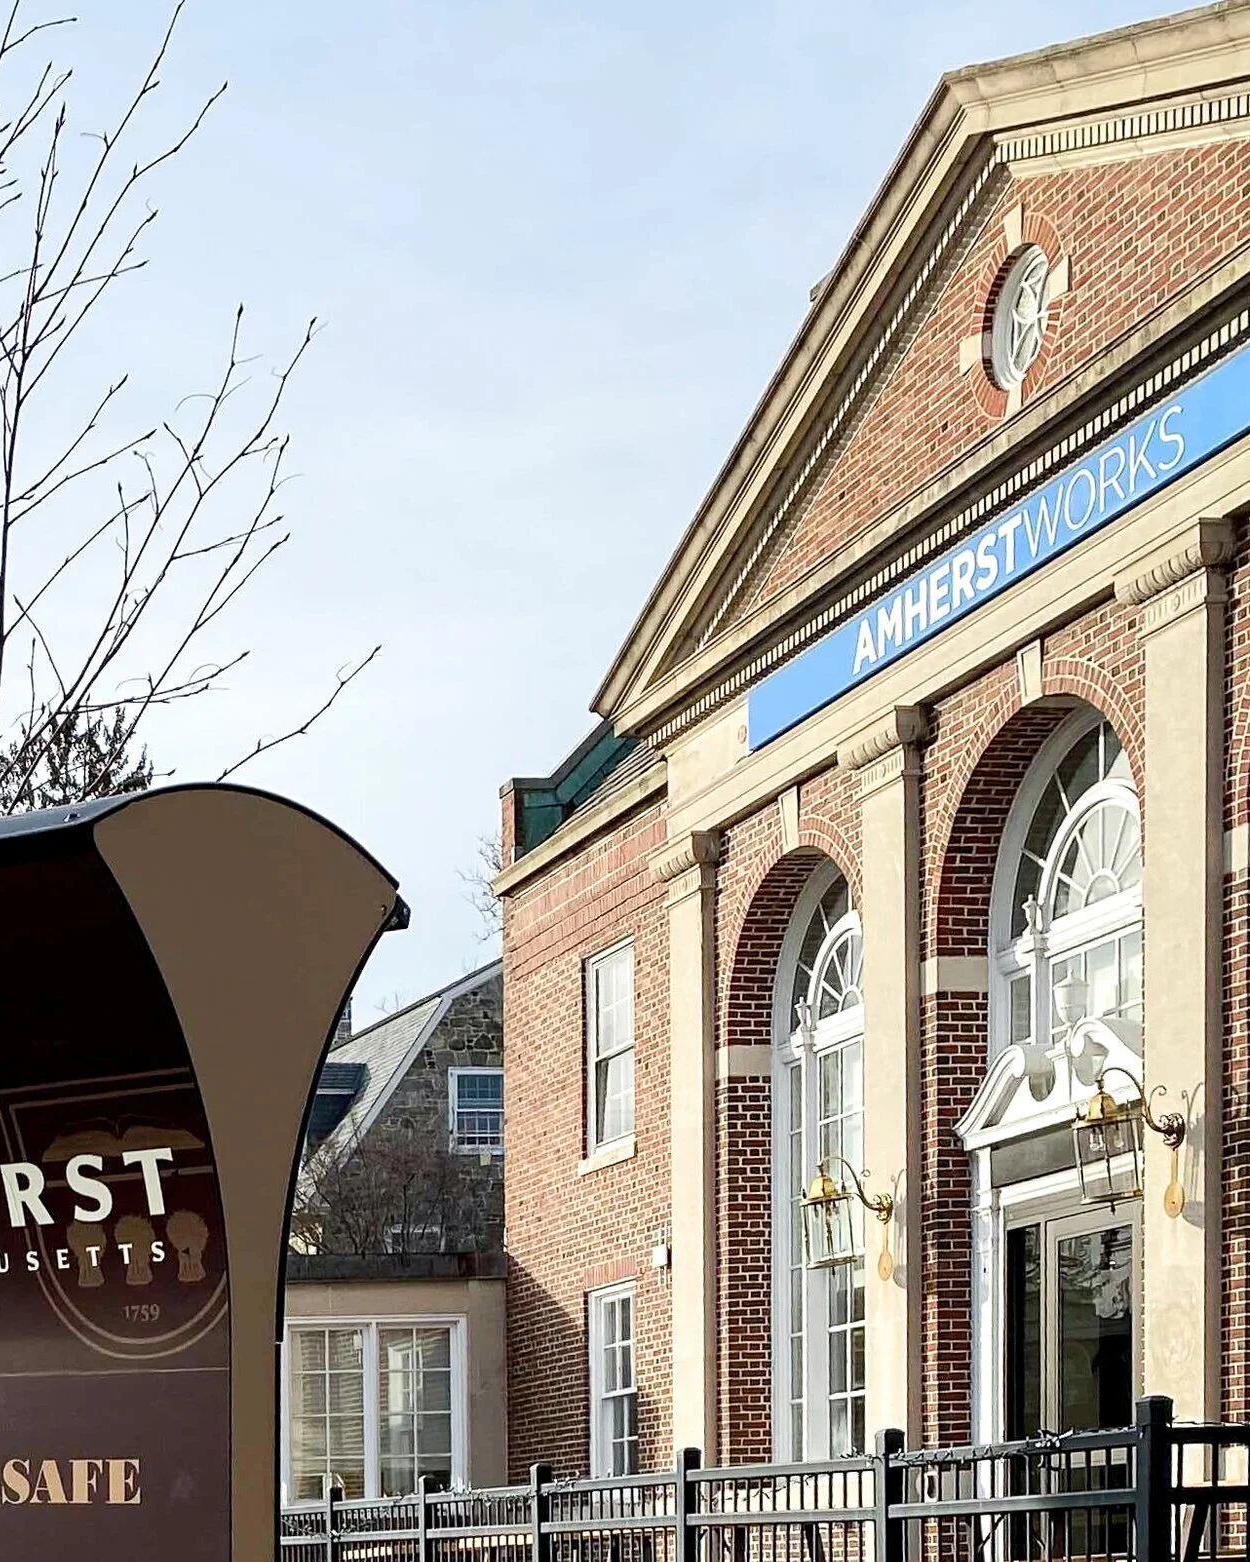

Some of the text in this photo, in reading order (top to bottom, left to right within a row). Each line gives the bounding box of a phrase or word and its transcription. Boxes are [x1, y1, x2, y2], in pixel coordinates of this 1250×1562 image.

[852, 405, 1186, 675] AMHERSTWORKS
[122, 1303, 161, 1322] 1759
[1, 1458, 142, 1505] SAFE
